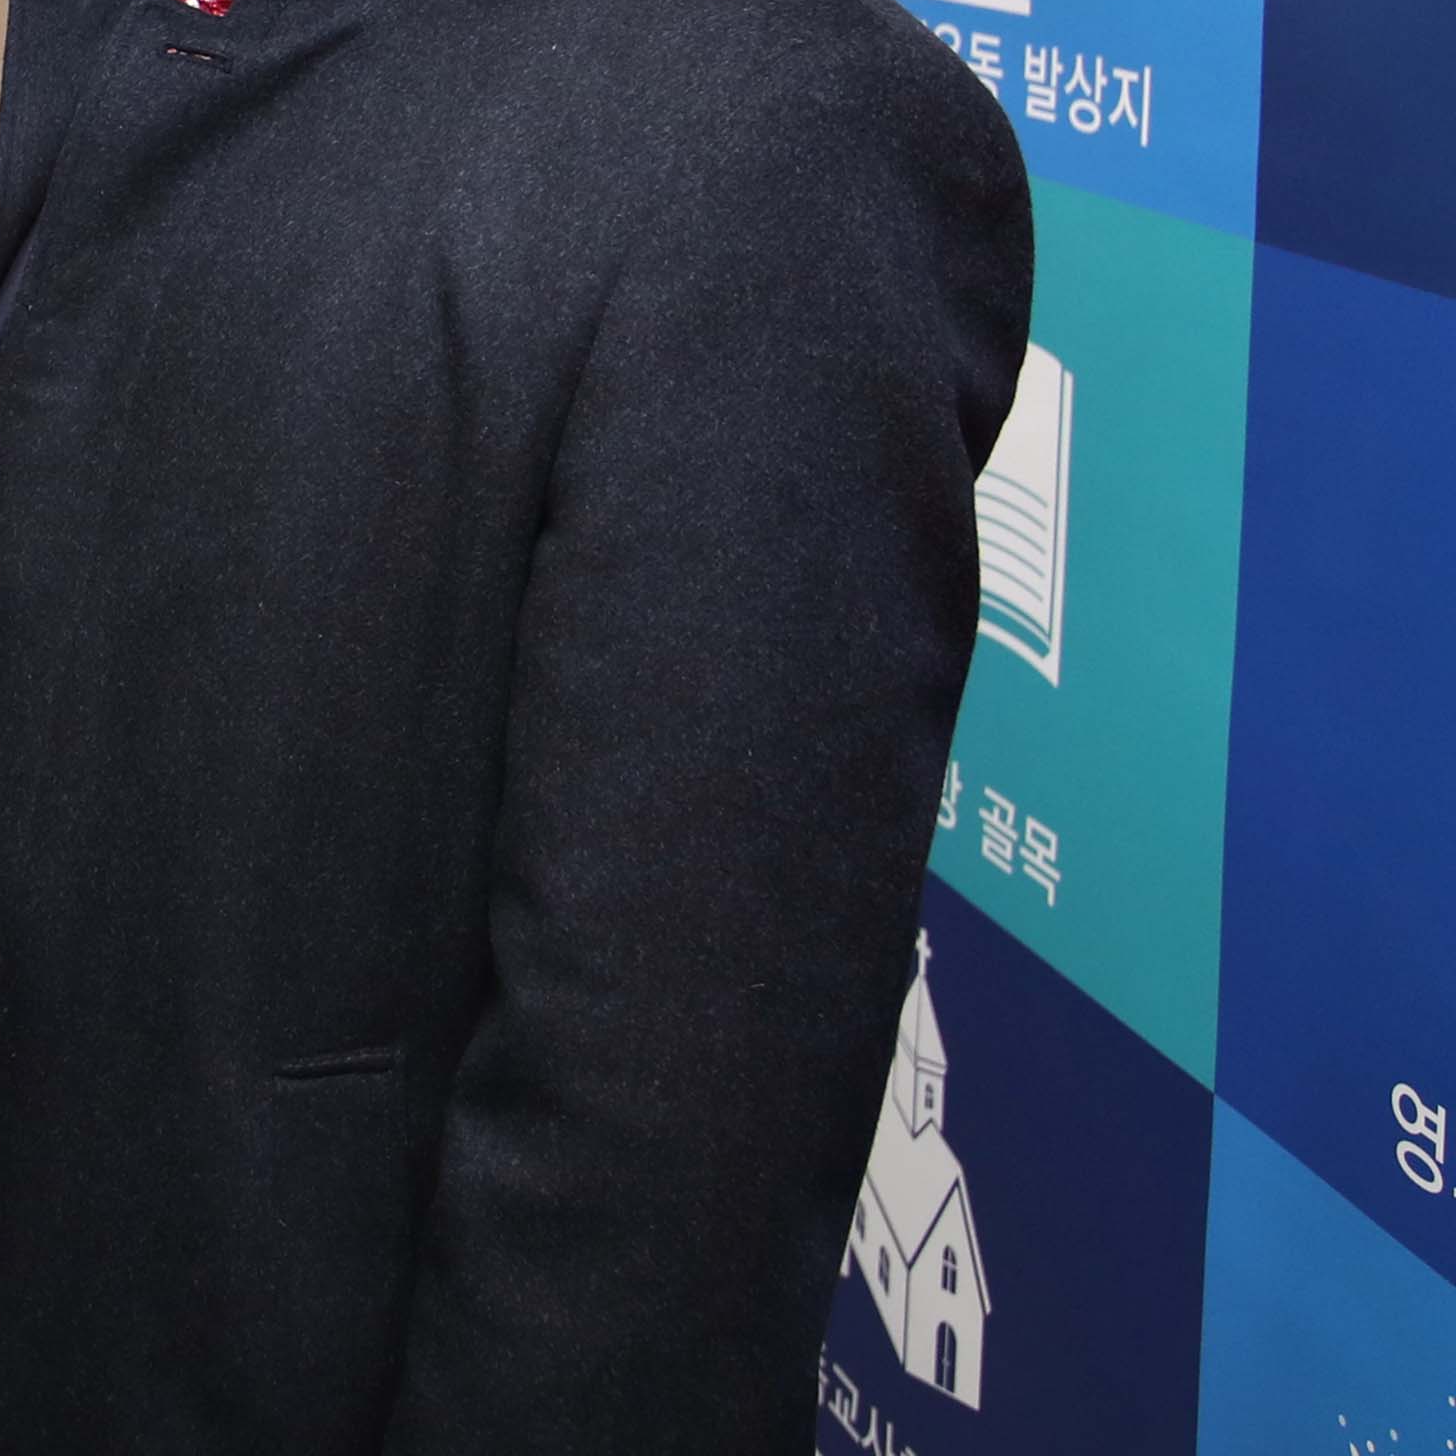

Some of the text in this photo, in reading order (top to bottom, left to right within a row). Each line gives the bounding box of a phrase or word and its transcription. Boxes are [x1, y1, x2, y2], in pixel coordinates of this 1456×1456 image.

[1022, 43, 1153, 148] 발상지
[978, 784, 1062, 909] 골목
[1391, 1082, 1456, 1200] 영
